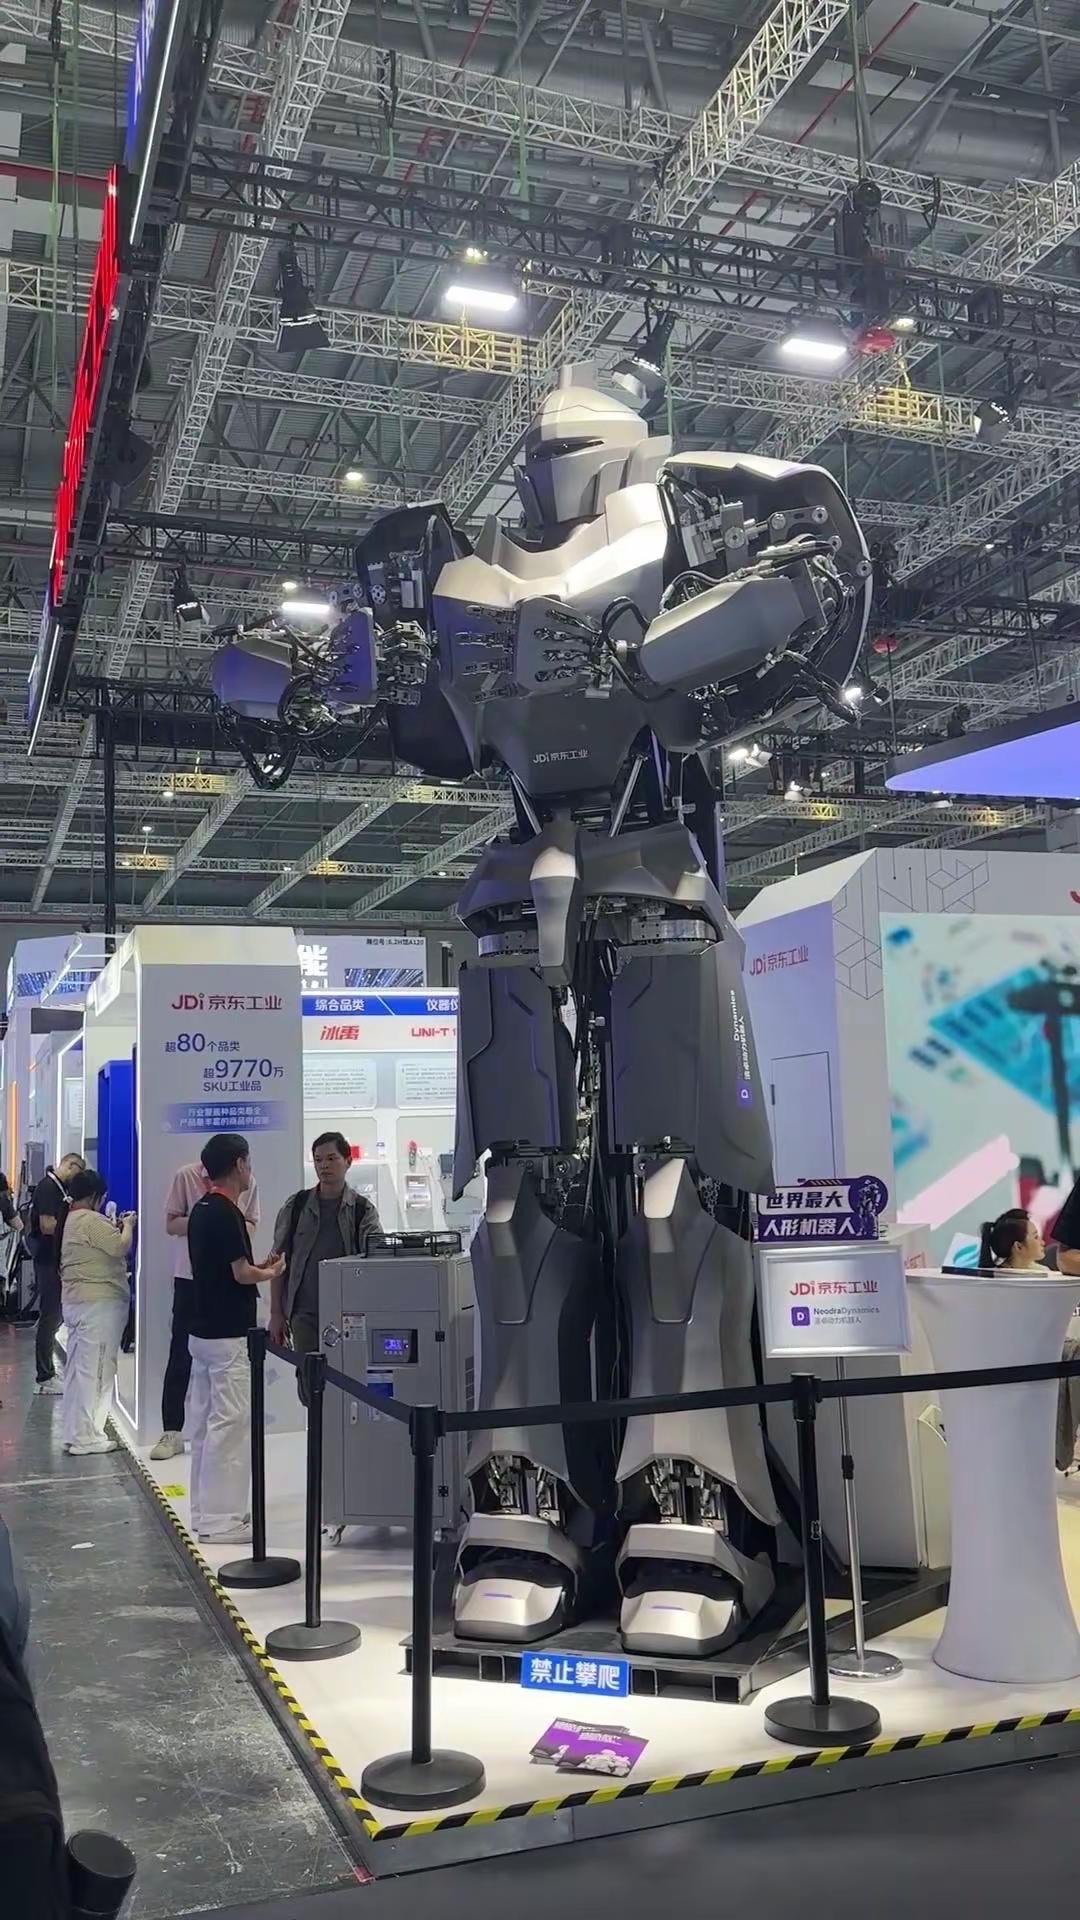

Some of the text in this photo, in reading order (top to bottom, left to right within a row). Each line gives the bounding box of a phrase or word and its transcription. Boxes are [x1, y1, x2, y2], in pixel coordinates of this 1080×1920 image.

[171, 992, 283, 1010] JDi 京东工业
[315, 998, 365, 1011] 综合品类
[411, 1027, 450, 1037] UNI-T
[165, 1033, 241, 1052] 超80个品类
[203, 1059, 284, 1079] 超9770万
[203, 1081, 262, 1092] SKU工业品
[766, 1190, 843, 1209] 世界最大
[763, 1216, 856, 1236] 人形机器人
[789, 1280, 879, 1296] JDi 京东工业
[530, 1657, 620, 1690] 禁止攀爬
